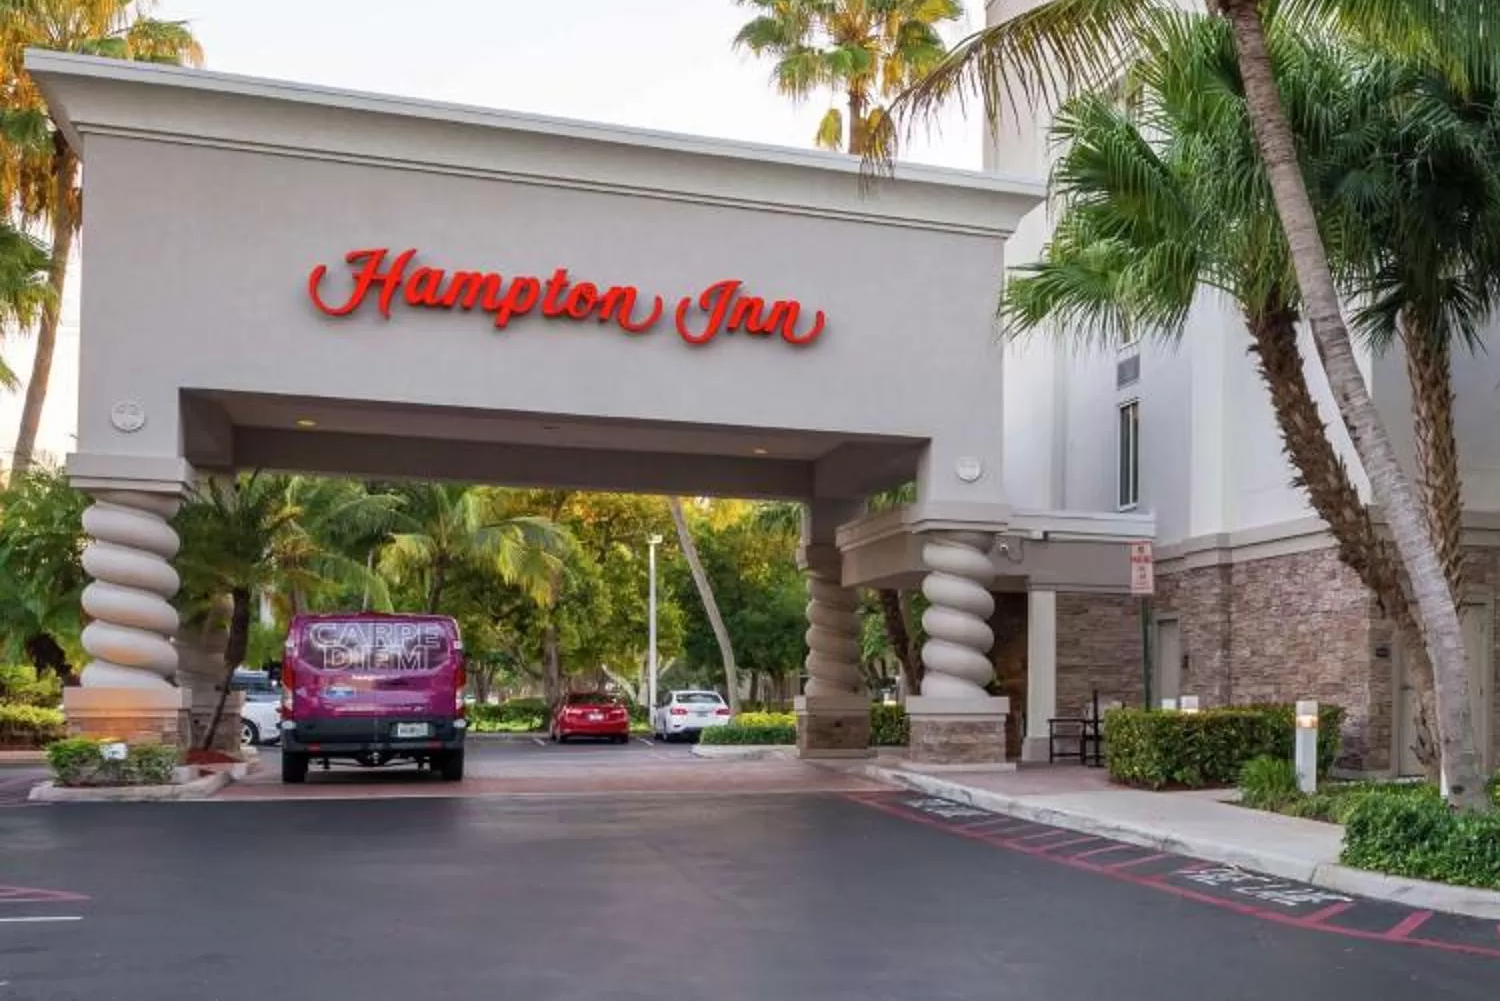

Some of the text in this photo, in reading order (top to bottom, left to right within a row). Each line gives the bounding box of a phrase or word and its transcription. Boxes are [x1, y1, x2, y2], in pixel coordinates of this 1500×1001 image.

[308, 248, 825, 345] Hampton Inn
[309, 622, 441, 648] CARPE
[323, 647, 429, 671] DIEM
